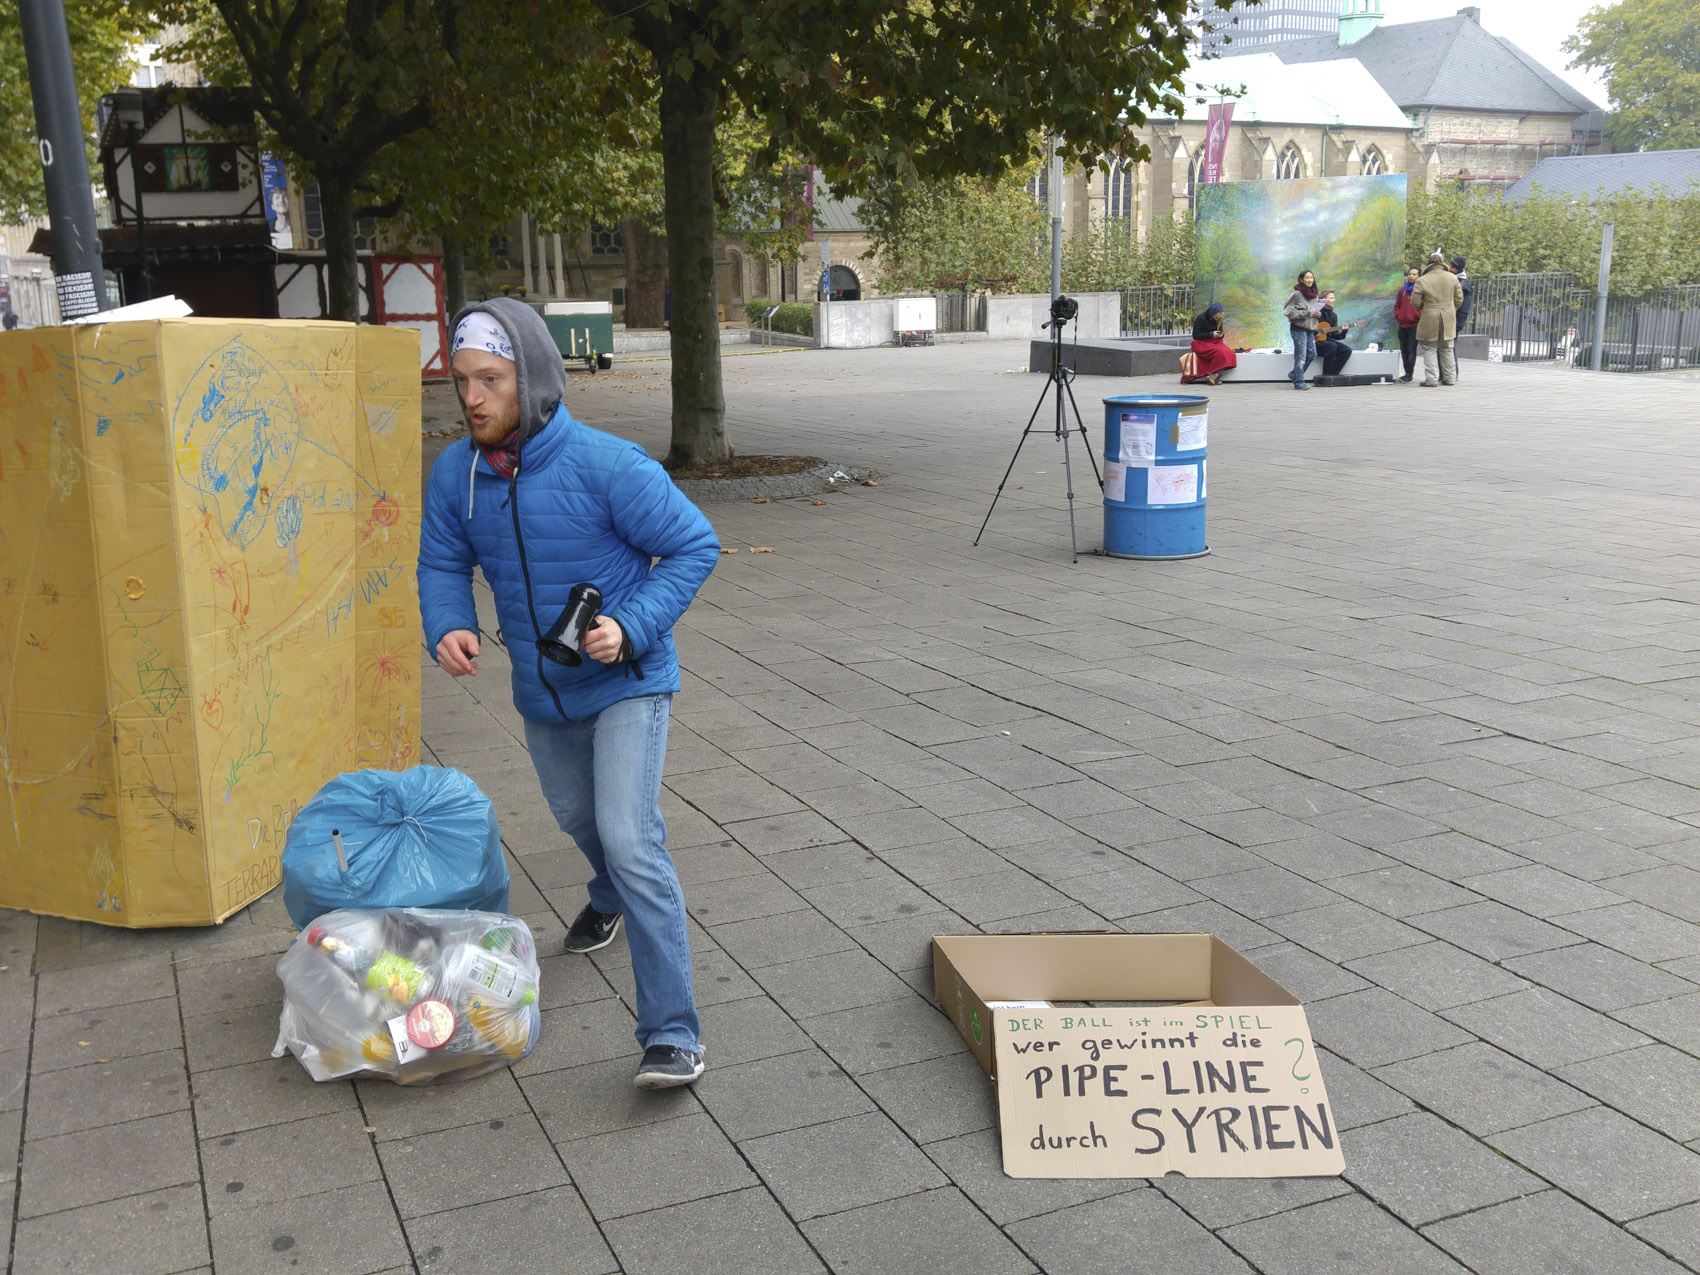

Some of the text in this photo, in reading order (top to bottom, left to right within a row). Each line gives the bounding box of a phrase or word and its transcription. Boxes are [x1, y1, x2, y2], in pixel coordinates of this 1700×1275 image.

[1008, 1014, 1273, 1032] DER BALL ist im SPIEL
[1013, 1031, 1263, 1061] wer gewinnt die
[1025, 1060, 1271, 1099] PIPE-LINE
[1030, 1103, 1334, 1154] durch SYRIEN
